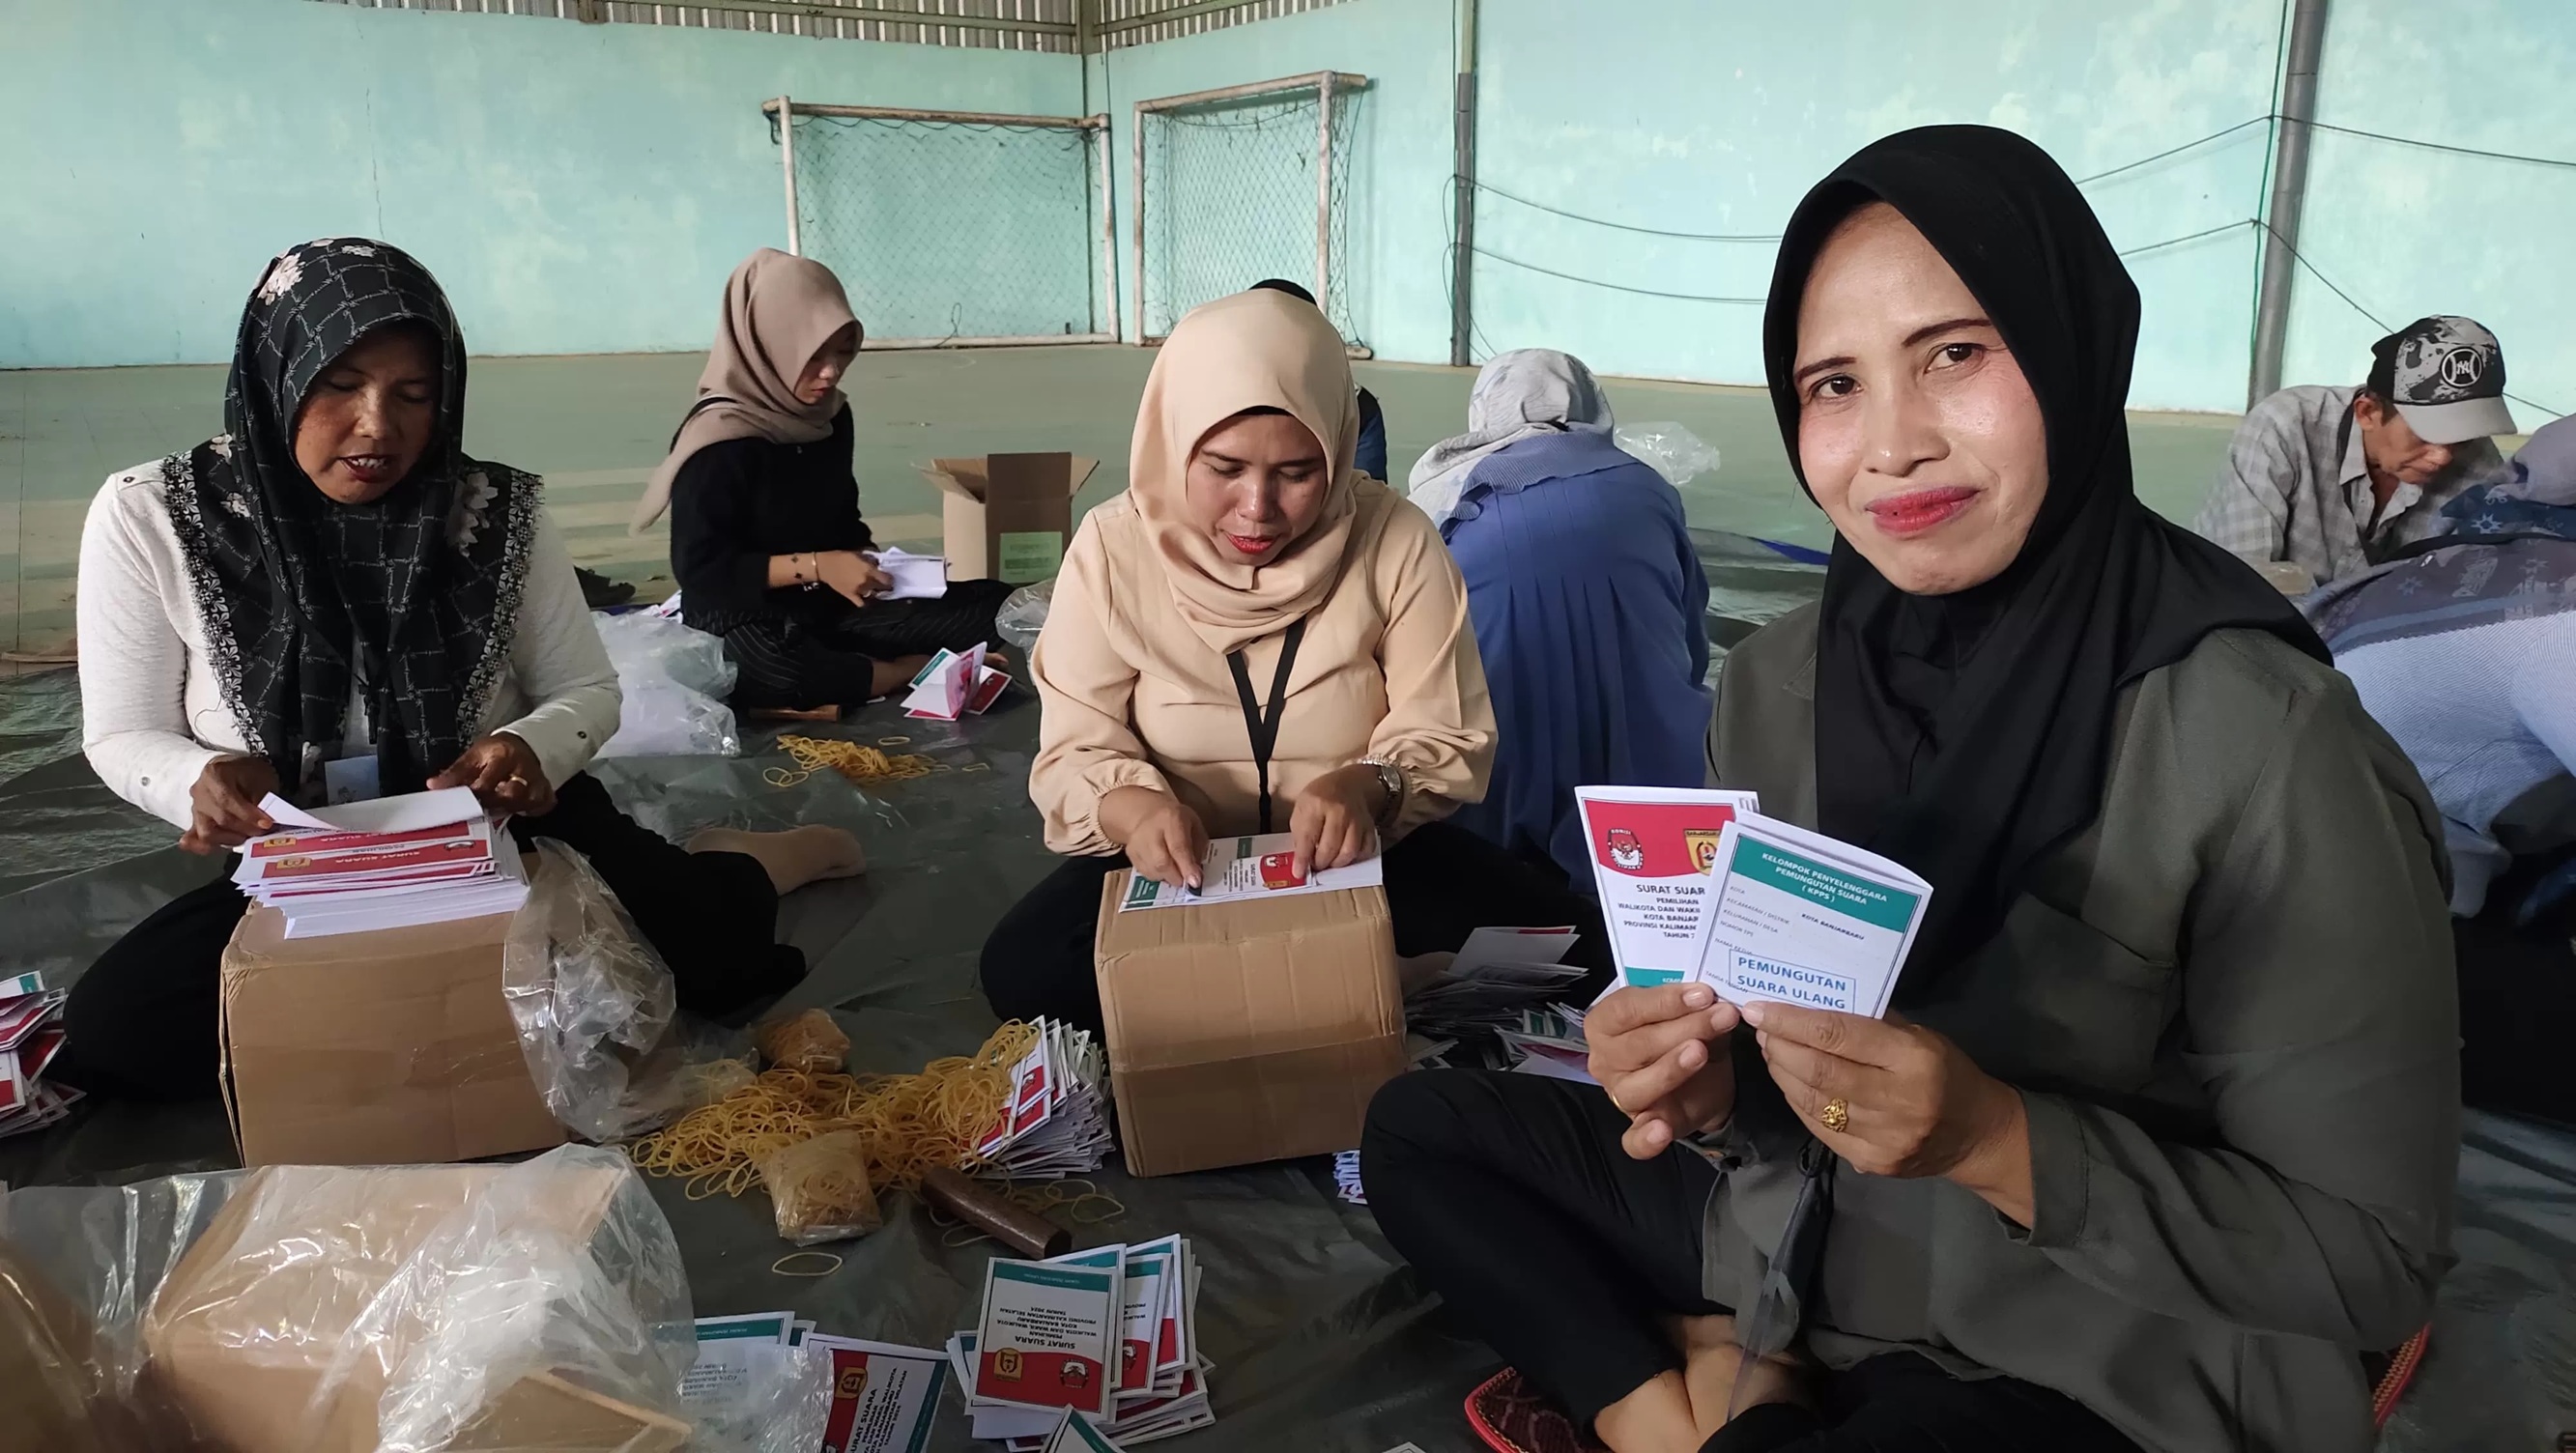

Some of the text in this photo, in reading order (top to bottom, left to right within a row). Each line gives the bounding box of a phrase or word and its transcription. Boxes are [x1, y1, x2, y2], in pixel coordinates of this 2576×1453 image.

[1761, 852, 1887, 902] KELOMPOK PENYELENGGARA
[1775, 866, 1868, 905] PEMUNGUTAN SUARA
[1636, 884, 1705, 896] SURAT SUAR
[1807, 886, 1830, 901] KPPS
[1617, 902, 1656, 912] WALIKOTA
[1656, 897, 1699, 905] PEMILIHAN
[1623, 920, 1658, 928] PROVINSI
[1801, 913, 1865, 941] KOTA BANJARBARU
[1737, 956, 1846, 991] PEMUNGUTAN
[1737, 975, 1846, 1010] SUARA ULANG
[1015, 1335, 1075, 1350] SURAT SUARA
[849, 1388, 877, 1453] URAT SUARA
